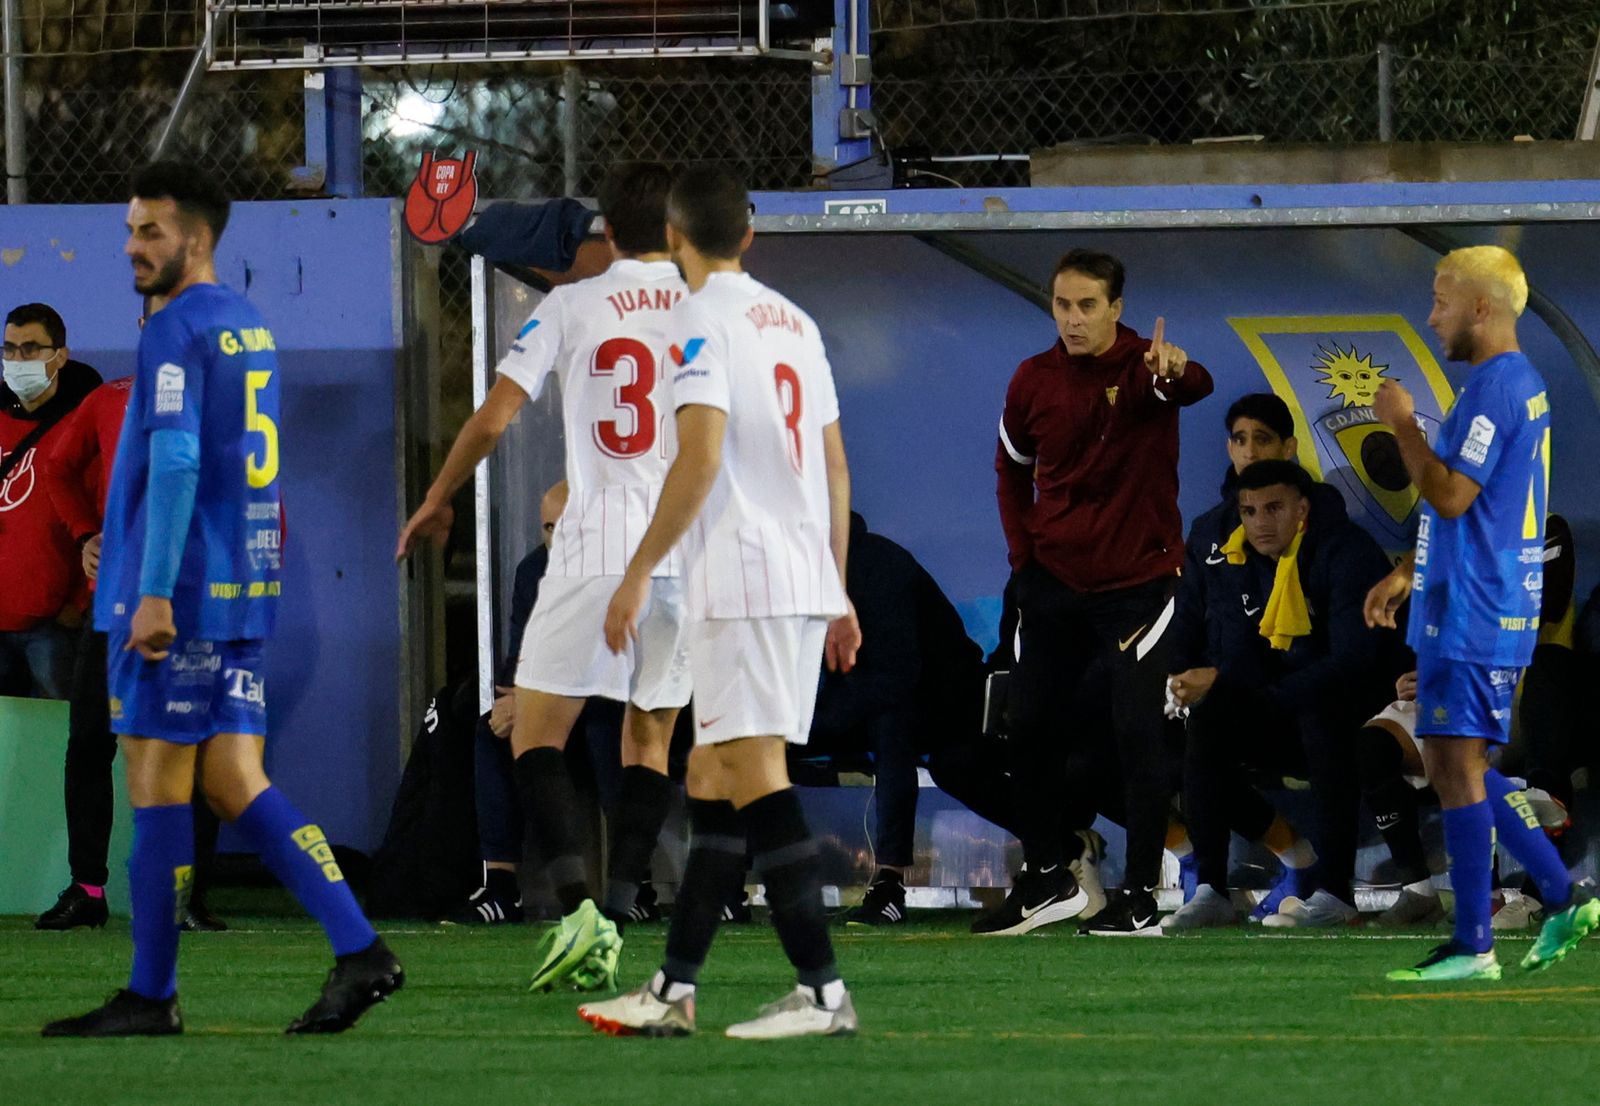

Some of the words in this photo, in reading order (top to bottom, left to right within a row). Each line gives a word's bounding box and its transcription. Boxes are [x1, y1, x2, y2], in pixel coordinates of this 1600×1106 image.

[436, 165, 456, 180] COPA
[606, 288, 683, 321] JUAN
[246, 370, 279, 488] 5
[590, 337, 668, 459] 3
